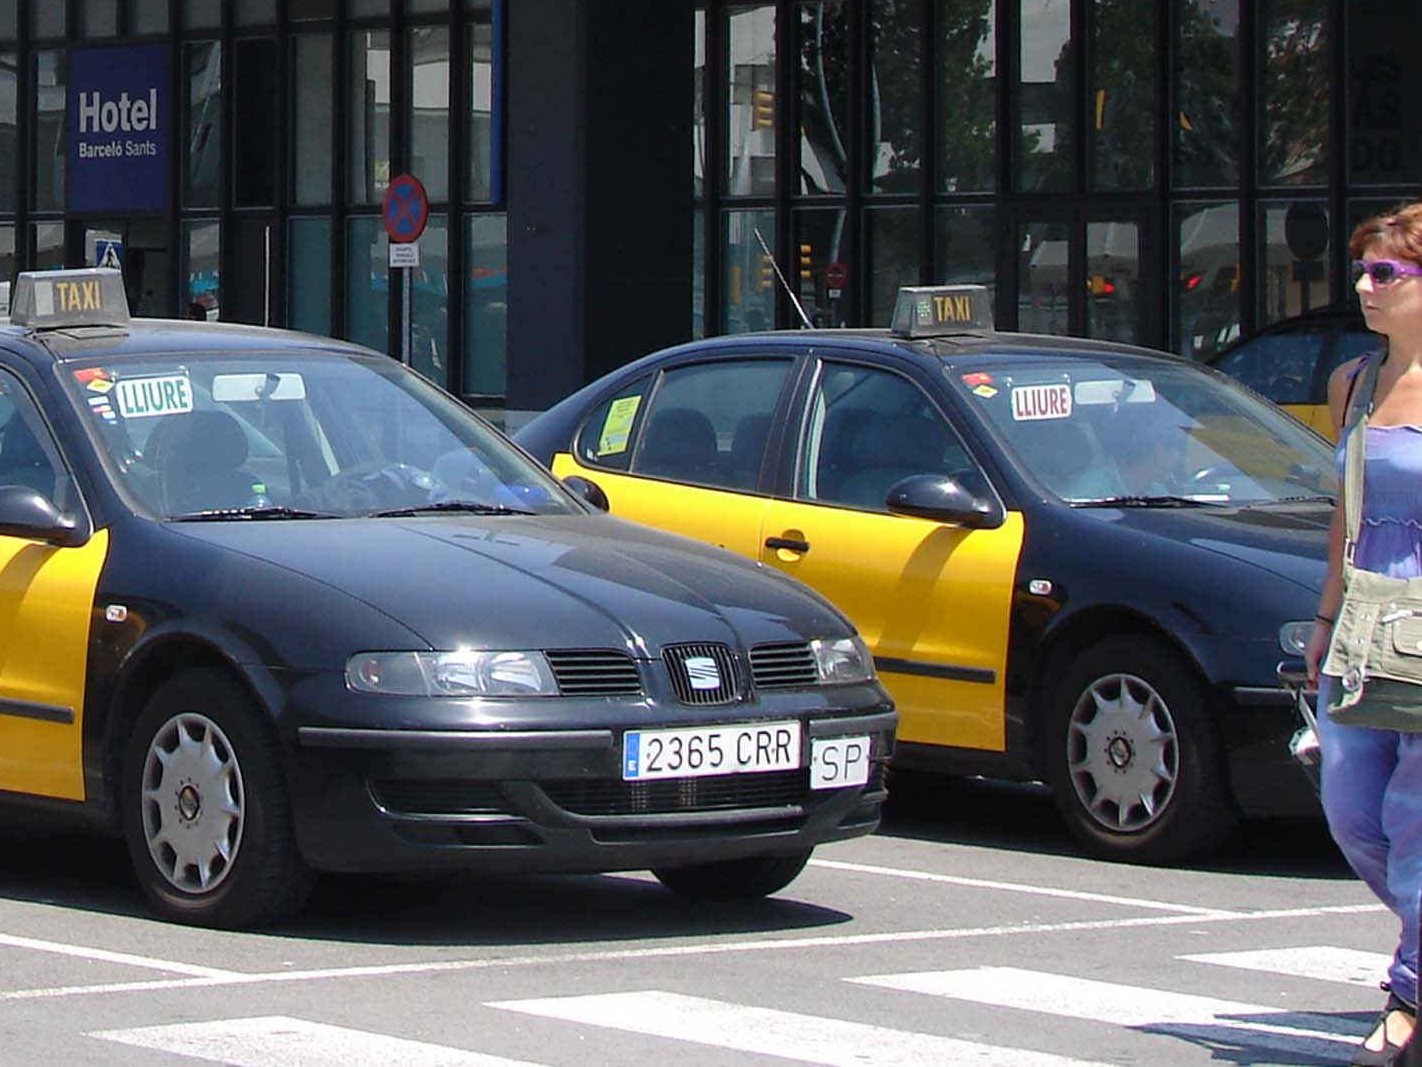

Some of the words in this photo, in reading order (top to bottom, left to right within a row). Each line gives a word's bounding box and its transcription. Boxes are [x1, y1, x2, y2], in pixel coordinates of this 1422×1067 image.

[79, 88, 157, 133] Hotel
[79, 140, 123, 158] Barceló
[125, 139, 157, 156] Sants
[58, 281, 101, 311] TAXI
[934, 295, 971, 322] TAXI
[121, 379, 188, 414] LLIURE
[1015, 387, 1068, 417] LLIURE
[646, 734, 724, 773] 2365
[736, 729, 792, 766] CRR
[821, 744, 863, 782] SP
